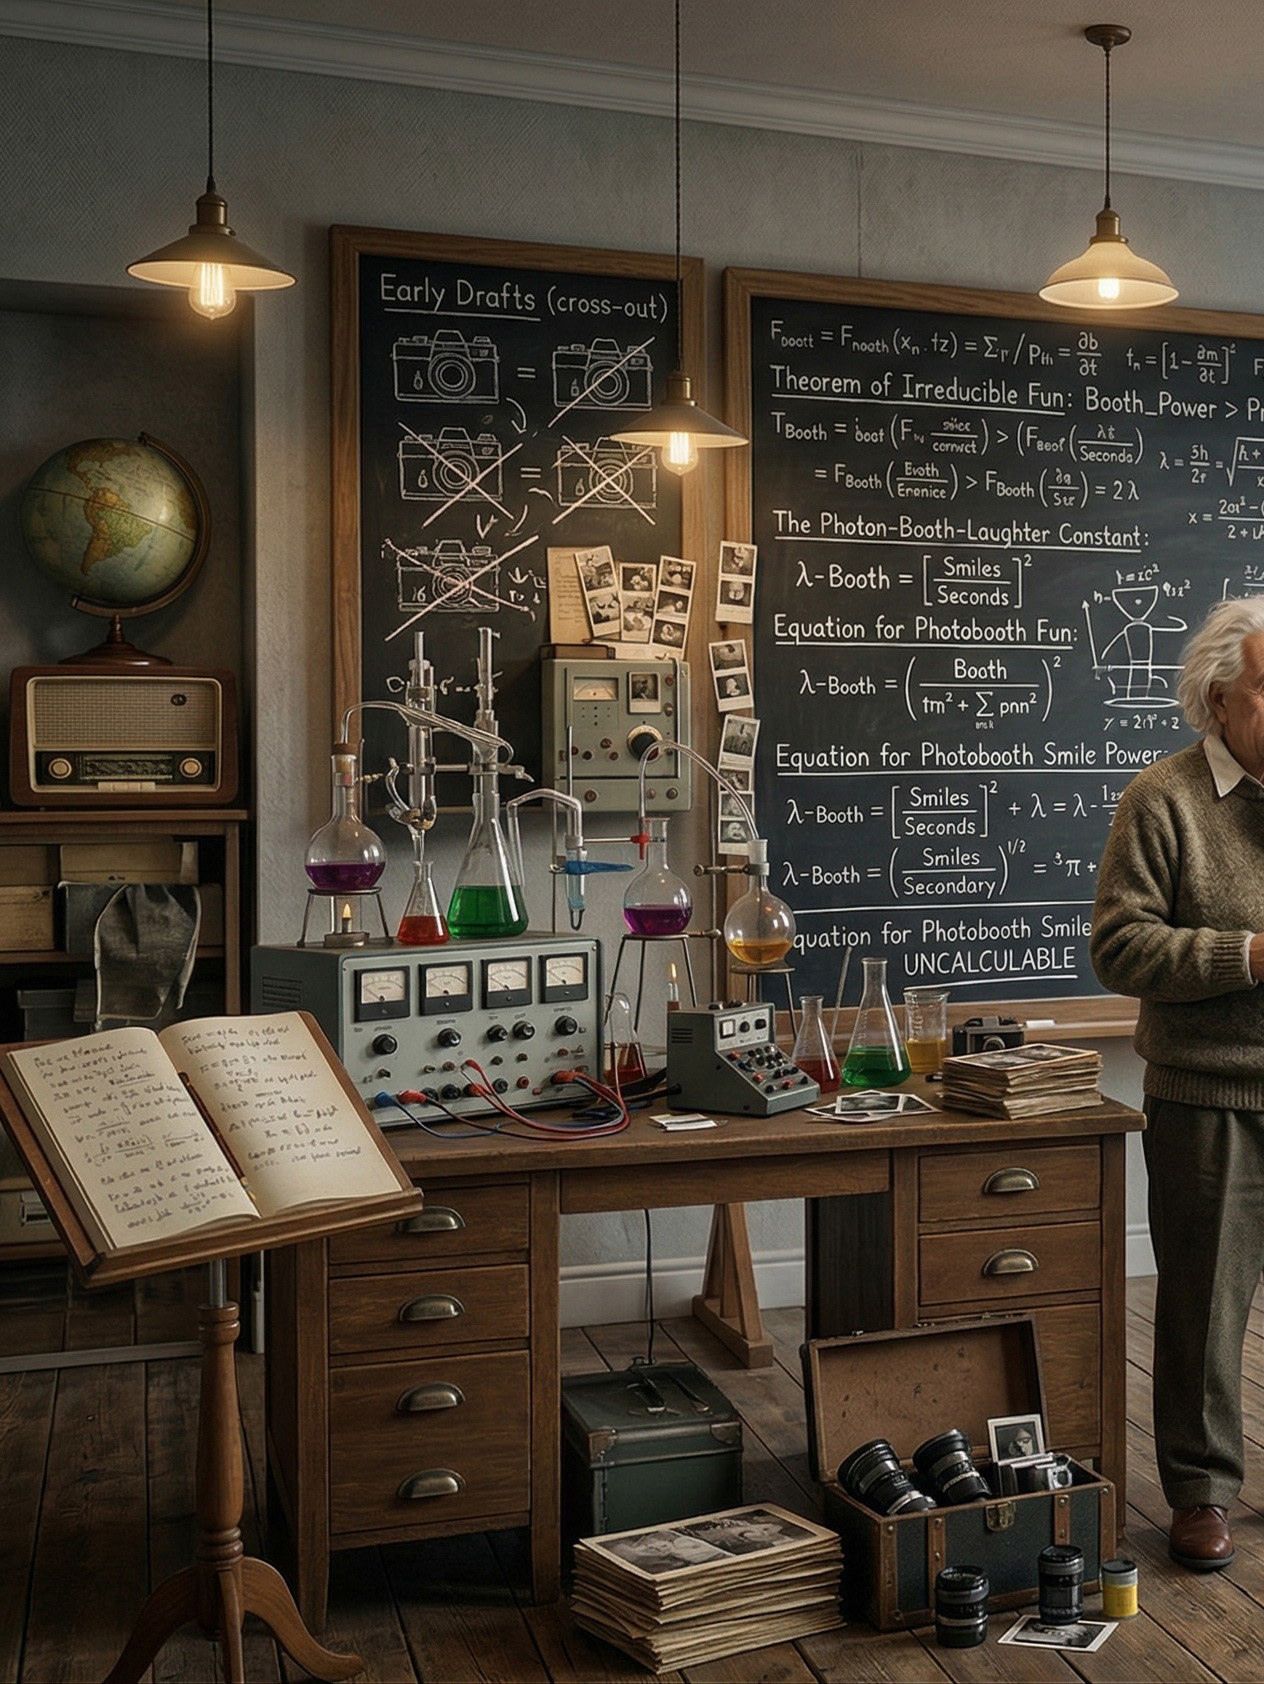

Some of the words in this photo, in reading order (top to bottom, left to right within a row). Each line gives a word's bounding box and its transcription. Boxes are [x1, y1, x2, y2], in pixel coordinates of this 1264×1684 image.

[381, 273, 445, 312] Early
[457, 279, 536, 311] Drafts
[548, 285, 668, 323] (cross-out)
[769, 365, 861, 396] Theorem
[870, 371, 893, 397] of
[902, 374, 1018, 405] Irreducible
[1027, 383, 1073, 409] Fun:
[1085, 386, 1218, 421] Booth_Power
[773, 509, 811, 534] The
[819, 512, 1051, 547] Photon-Booth-Laughter
[1059, 523, 1150, 547] Constant:
[796, 560, 890, 589] λ-Booth
[943, 555, 1002, 577] Smiles
[936, 584, 1009, 606] Seconds
[774, 614, 865, 645] Equation
[875, 614, 905, 639] for
[914, 616, 1027, 642] Photobooth
[1037, 617, 1078, 642] Fun:
[799, 669, 876, 695] λ-Booth
[776, 743, 870, 773] Equation
[880, 742, 911, 767] for
[921, 742, 1034, 767] Photobooth
[1043, 741, 1096, 765] Smile
[786, 799, 864, 825] λ-Booth
[909, 786, 969, 808] Smiles
[904, 817, 976, 837] Seconds
[782, 861, 860, 888] λ-Booth
[922, 847, 980, 867] Smiles
[903, 875, 997, 897] Secondary
[794, 926, 871, 955] quation
[881, 921, 913, 944] for
[922, 916, 1032, 942] Photobooth
[1041, 914, 1092, 938] Smile
[904, 947, 1076, 976] UNCALCULABLE
